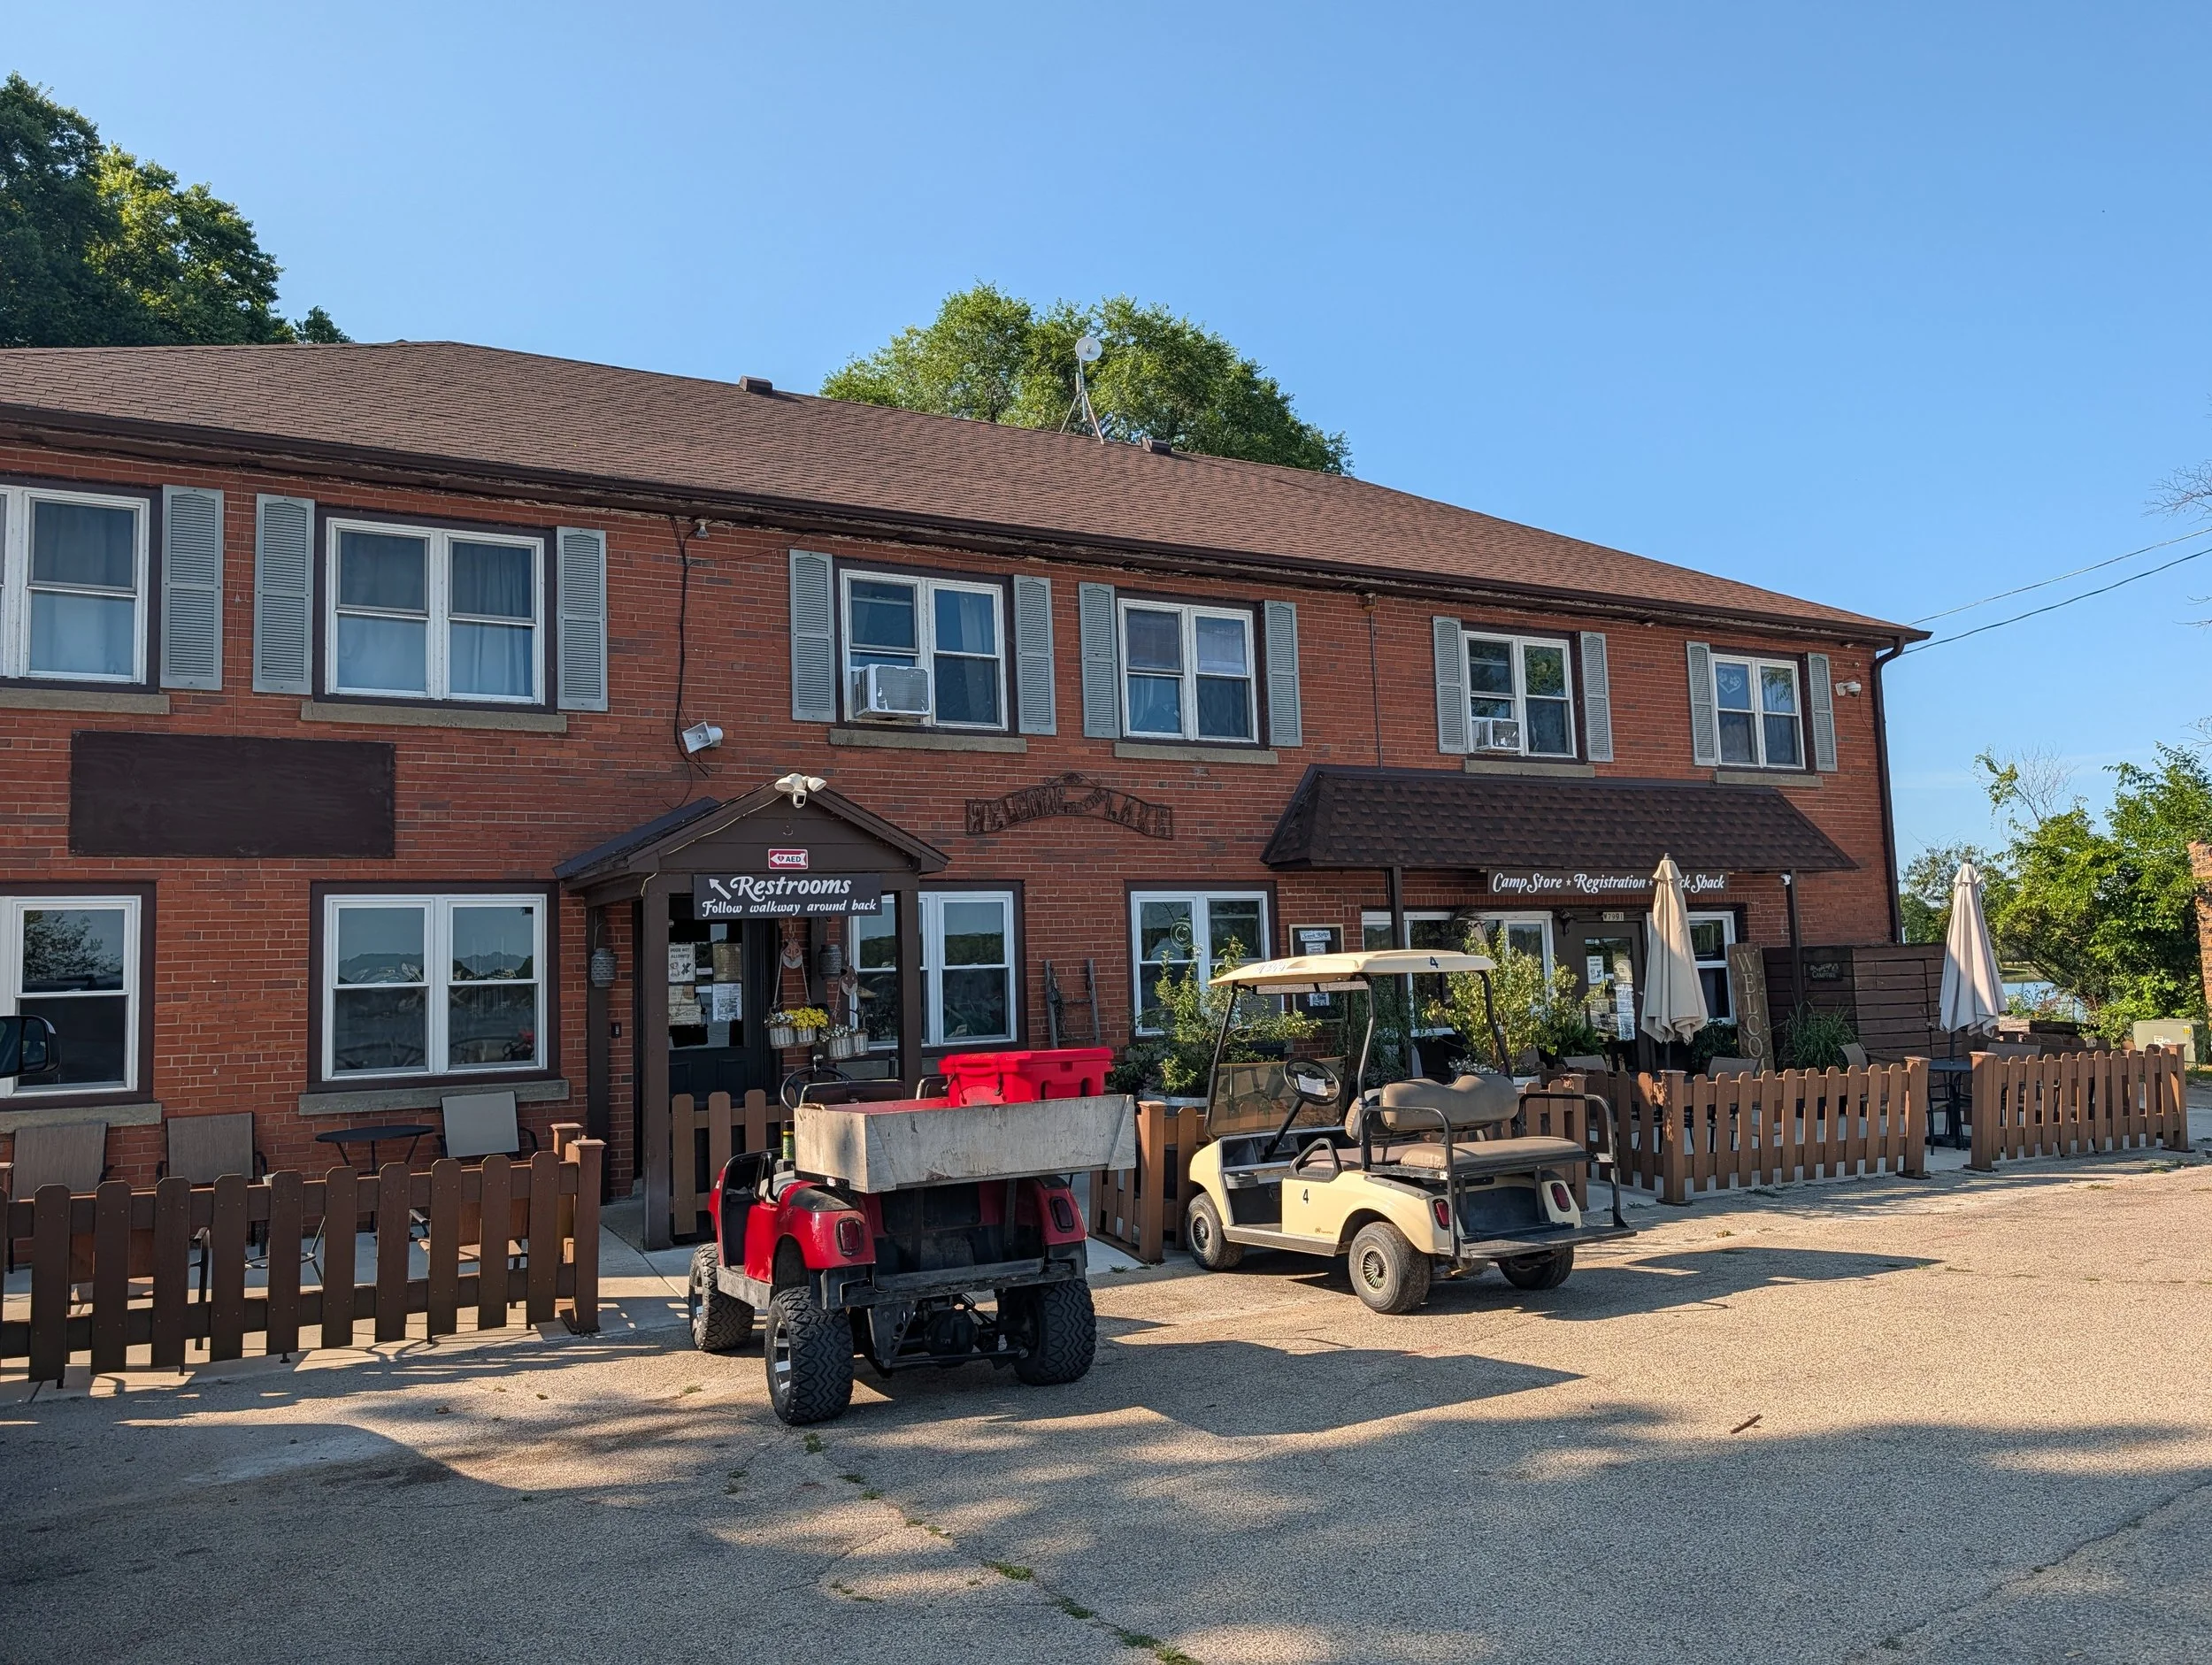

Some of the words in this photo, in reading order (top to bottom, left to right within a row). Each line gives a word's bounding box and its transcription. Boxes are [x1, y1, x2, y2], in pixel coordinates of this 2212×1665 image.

[1105, 790, 1169, 837] LAKE
[730, 876, 852, 902] Restrooms
[1493, 872, 1527, 894] Camp
[1526, 872, 1563, 894] Store
[1573, 874, 1647, 894] Registration
[1690, 874, 1724, 894] Shack
[702, 899, 742, 917] Follow
[749, 900, 801, 916] walkway
[806, 900, 846, 912] around
[851, 899, 877, 910] back
[1429, 955, 1439, 969] 4
[1302, 1188, 1309, 1204] 4
